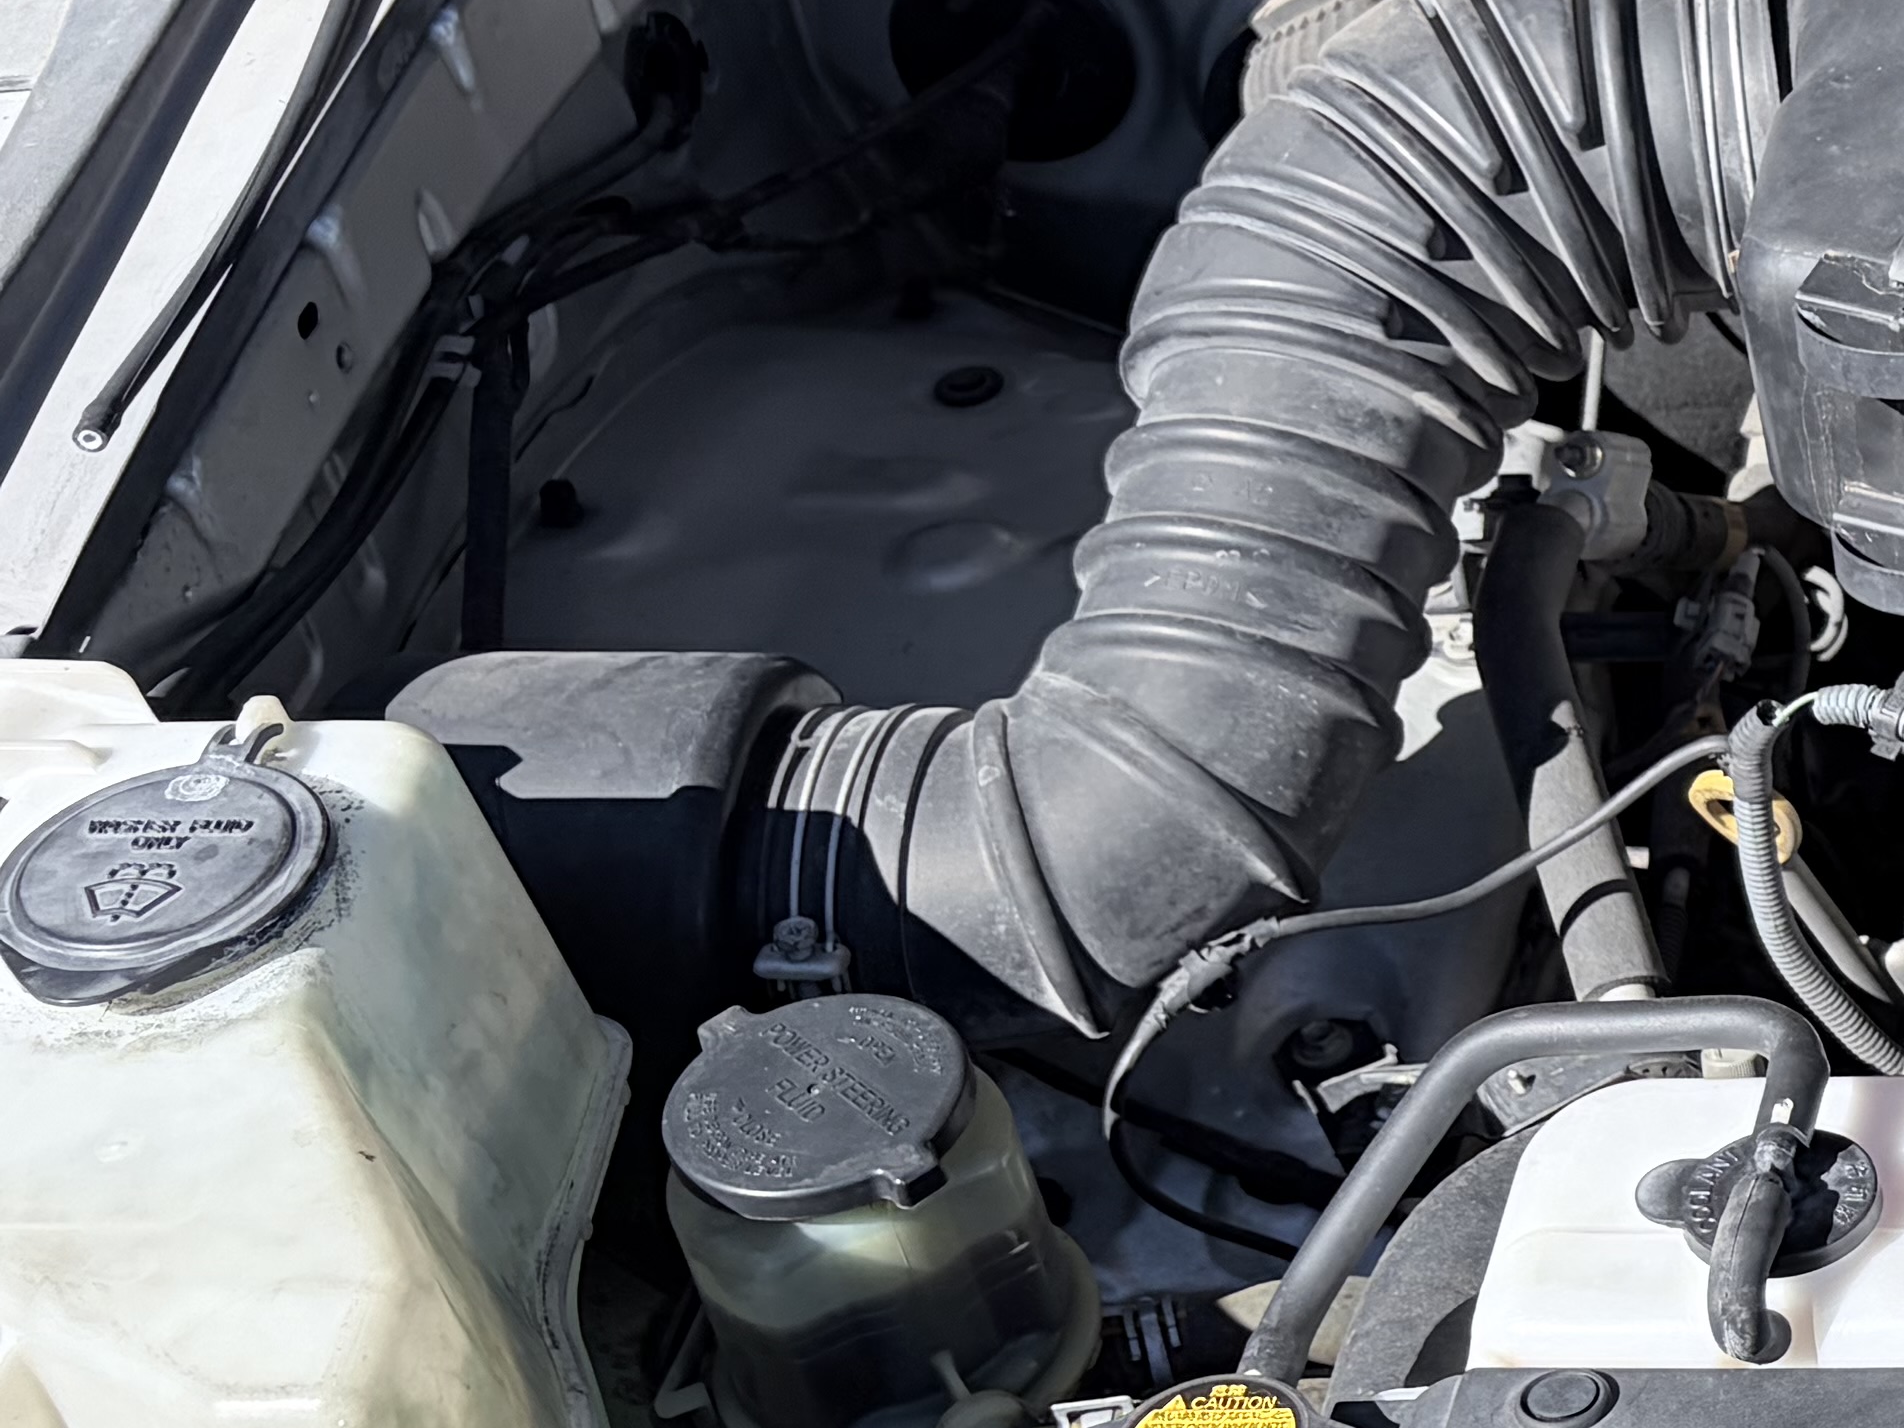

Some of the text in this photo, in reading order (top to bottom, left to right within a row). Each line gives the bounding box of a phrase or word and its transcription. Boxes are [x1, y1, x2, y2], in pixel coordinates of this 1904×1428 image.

[758, 1022, 830, 1074] POWER
[822, 1066, 910, 1137] STEERING
[767, 1077, 827, 1122] FLUID
[1191, 1396, 1279, 1410] CAUTION
